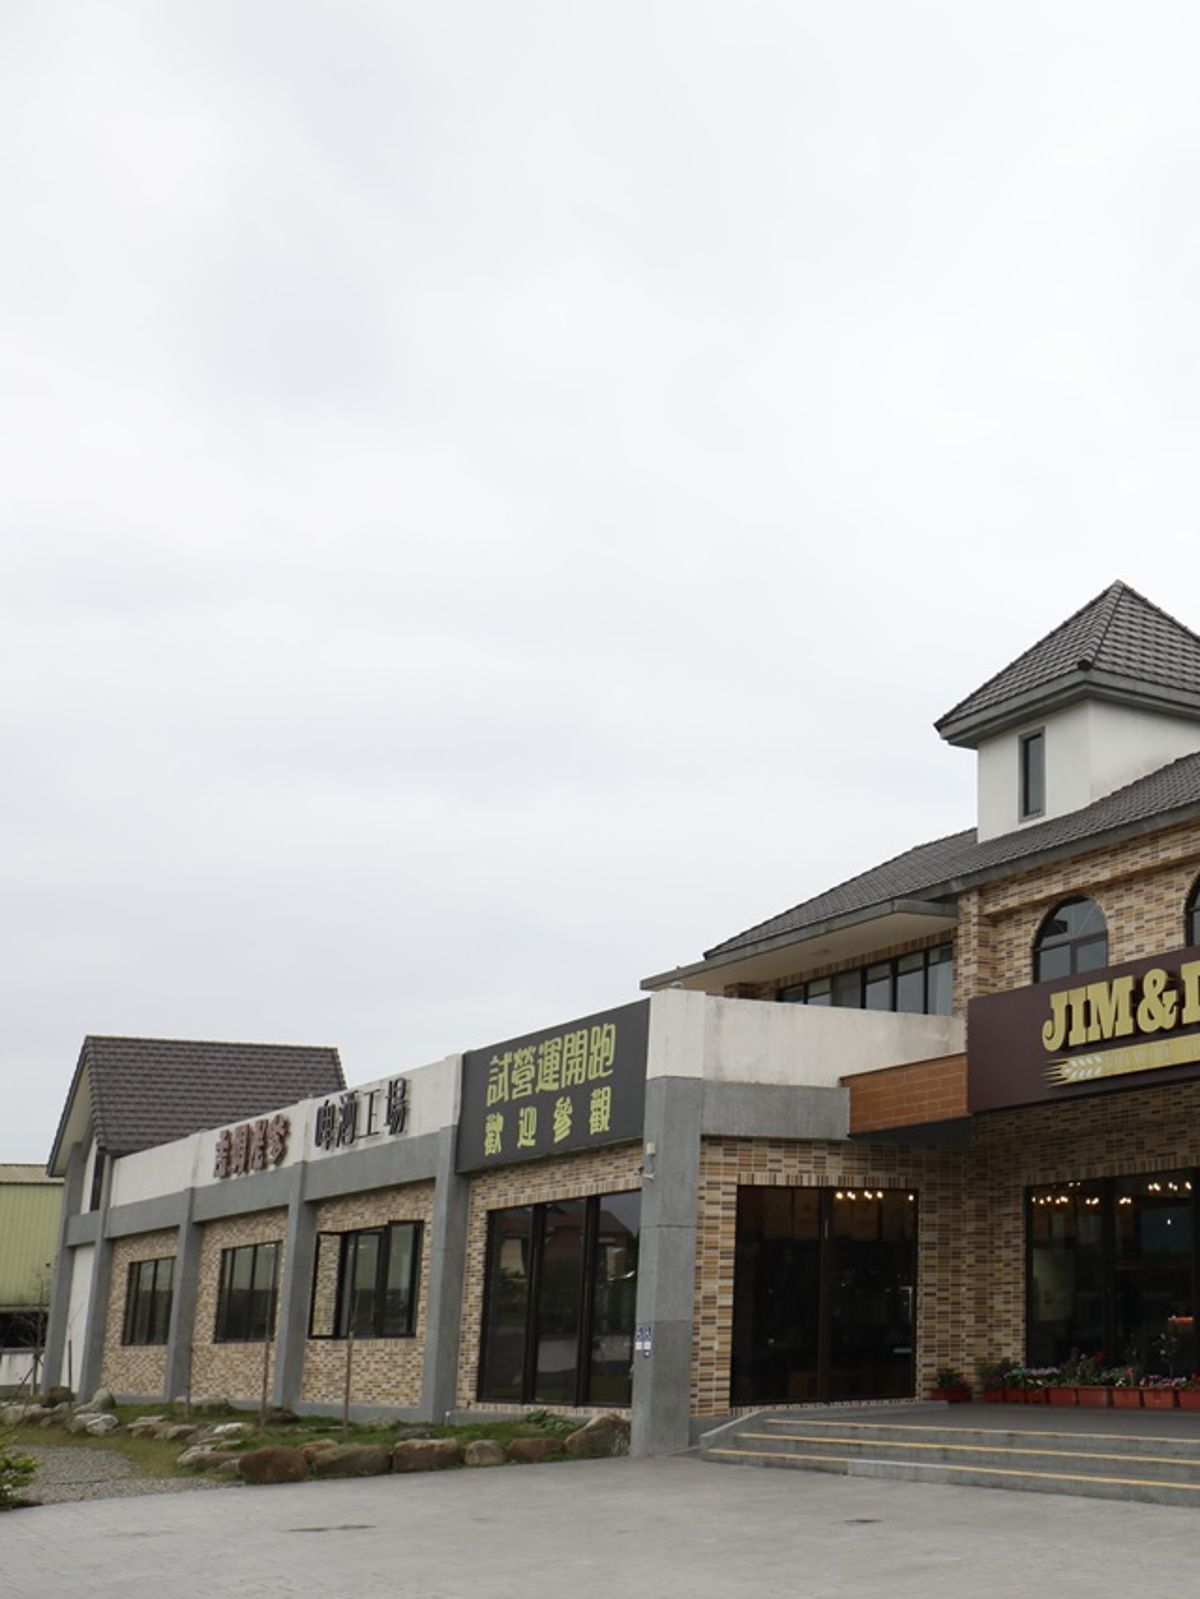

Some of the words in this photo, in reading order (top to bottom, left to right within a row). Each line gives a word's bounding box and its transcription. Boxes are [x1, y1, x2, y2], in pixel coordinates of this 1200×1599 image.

[486, 1023, 616, 1107] 試營運開跑
[315, 1077, 410, 1151] 啤酒工場
